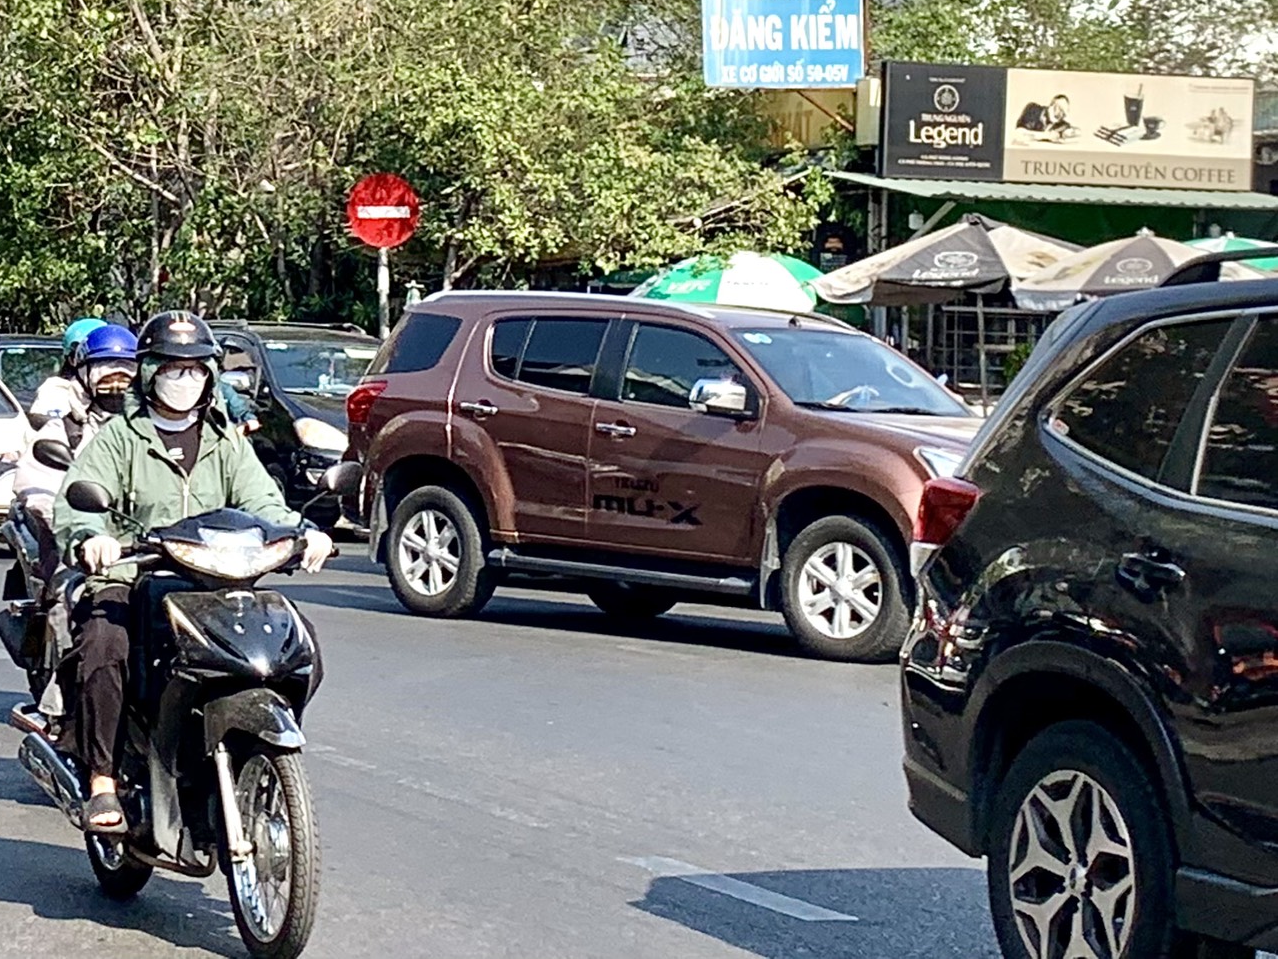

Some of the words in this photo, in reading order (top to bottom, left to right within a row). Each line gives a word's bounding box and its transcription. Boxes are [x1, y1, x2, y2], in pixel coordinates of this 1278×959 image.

[710, 9, 783, 51] ĐĂNG
[787, 57, 805, 83] SỐ
[909, 119, 983, 148] Legend
[1021, 160, 1086, 177] TRUNG
[1091, 162, 1167, 180] NGUYÊN
[1172, 167, 1236, 184] COFFEE
